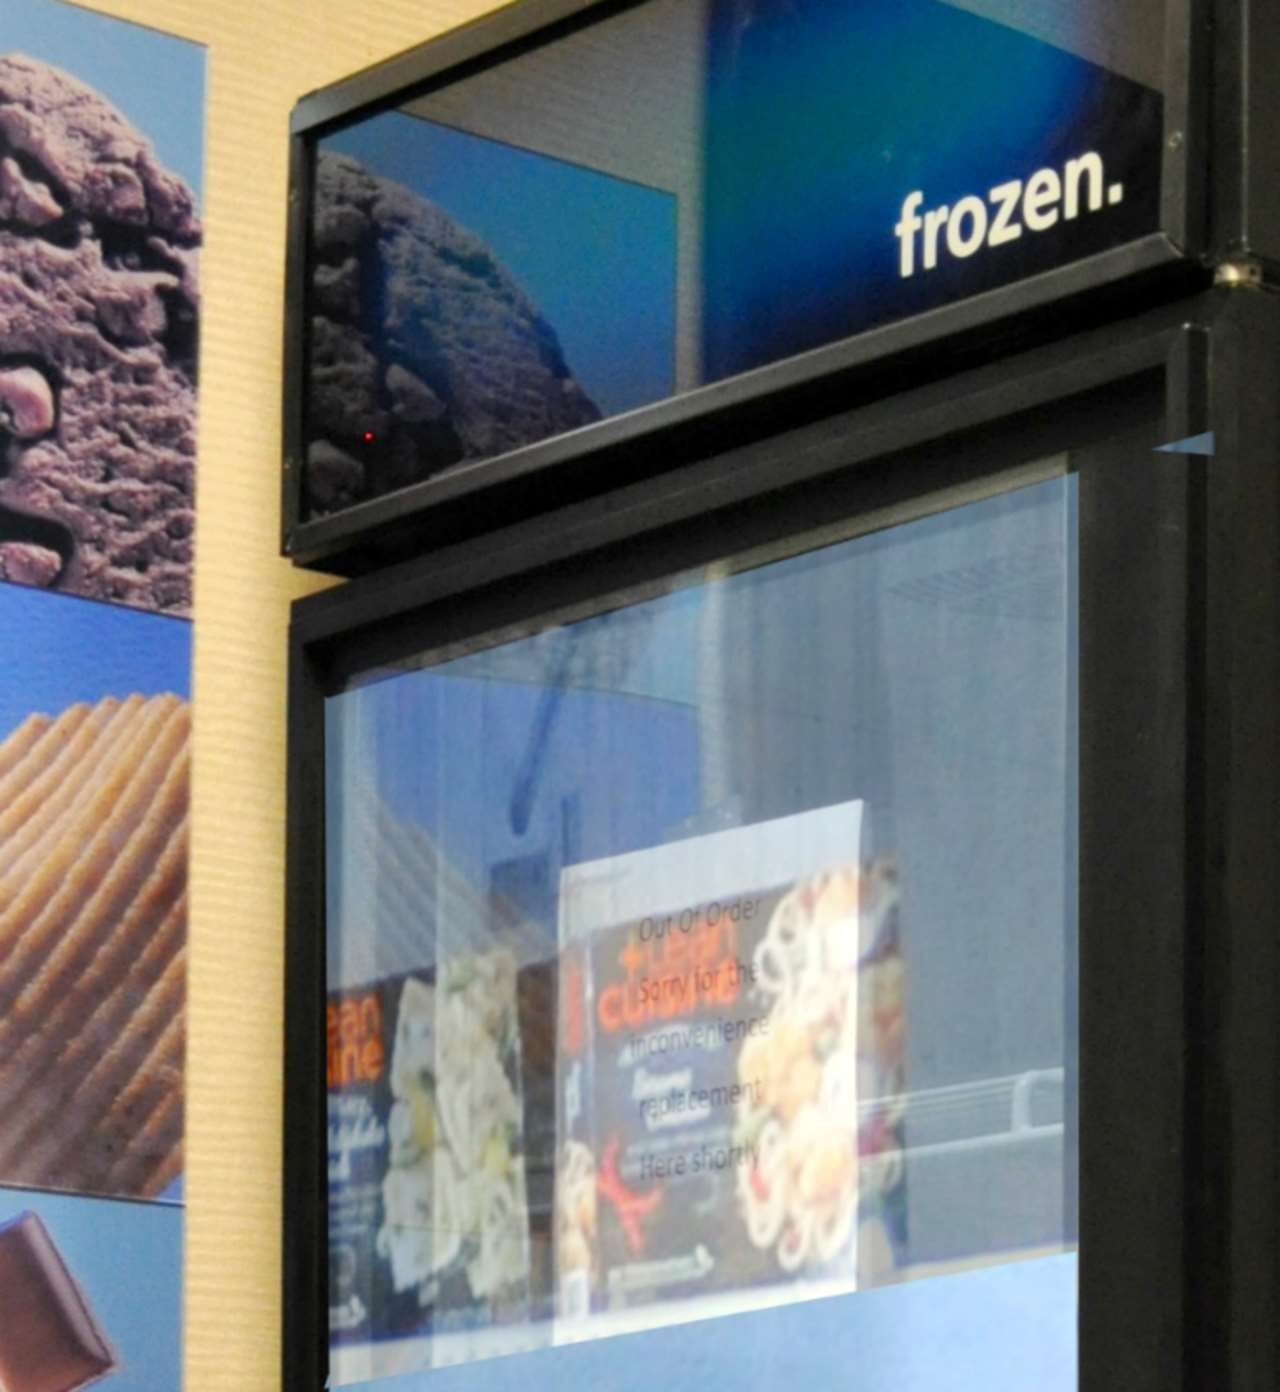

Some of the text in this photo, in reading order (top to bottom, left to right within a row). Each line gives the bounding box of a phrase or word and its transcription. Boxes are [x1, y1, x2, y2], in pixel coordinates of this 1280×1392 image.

[894, 151, 1123, 278] frozen.
[639, 911, 673, 943] Out
[705, 898, 760, 926] Order
[639, 955, 760, 1004] Sorry for the
[629, 1016, 771, 1057] inconvenience
[639, 1077, 764, 1118] replacement
[640, 1137, 761, 1181] Here shortly
